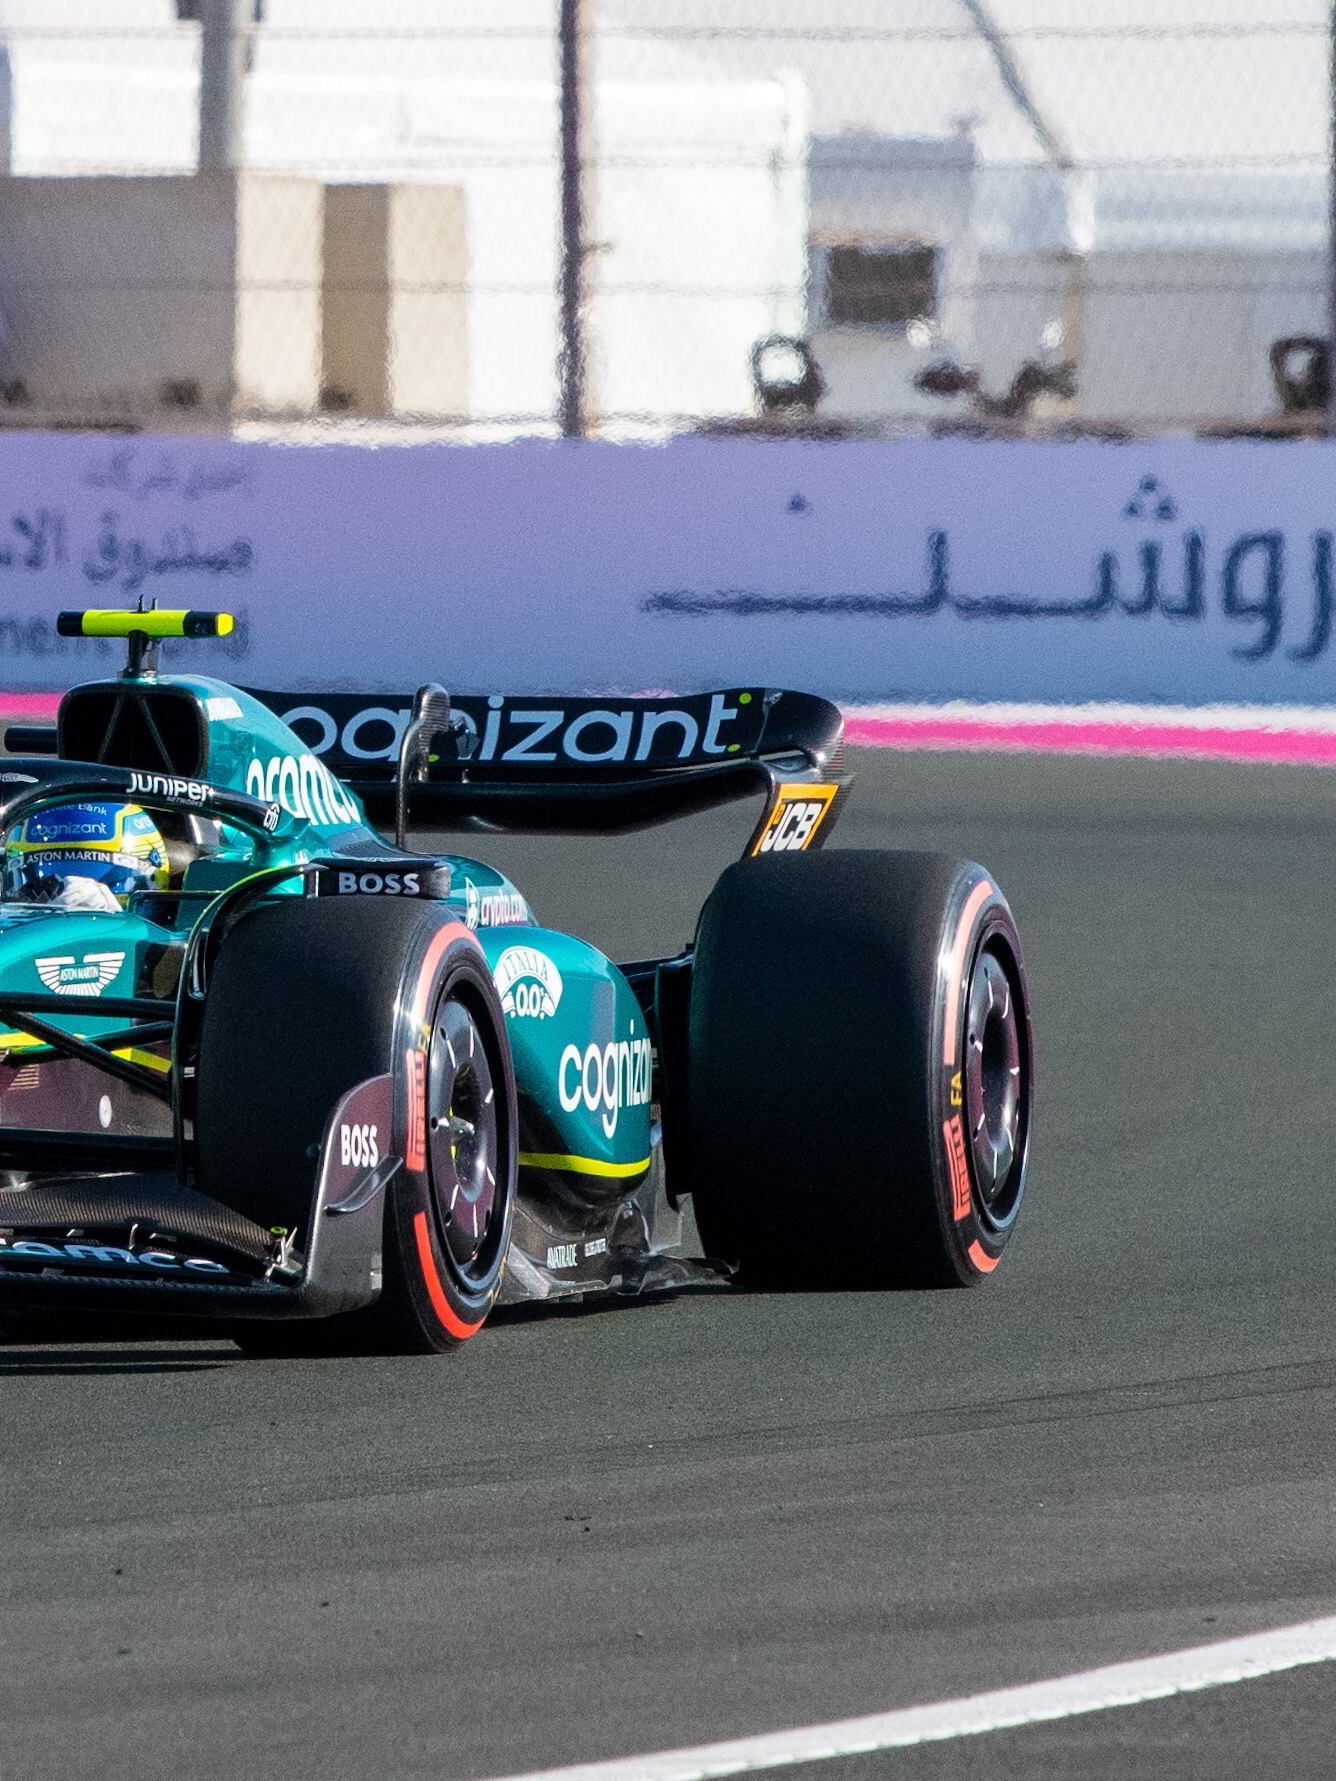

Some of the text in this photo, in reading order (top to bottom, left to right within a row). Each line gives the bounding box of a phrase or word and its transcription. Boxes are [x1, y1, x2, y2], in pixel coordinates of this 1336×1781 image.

[31, 821, 107, 839] cognizant
[760, 802, 823, 852] JCB
[27, 851, 111, 864] ASTON MARTIN
[338, 871, 420, 896] BOSS
[341, 1124, 379, 1168] BOSS
